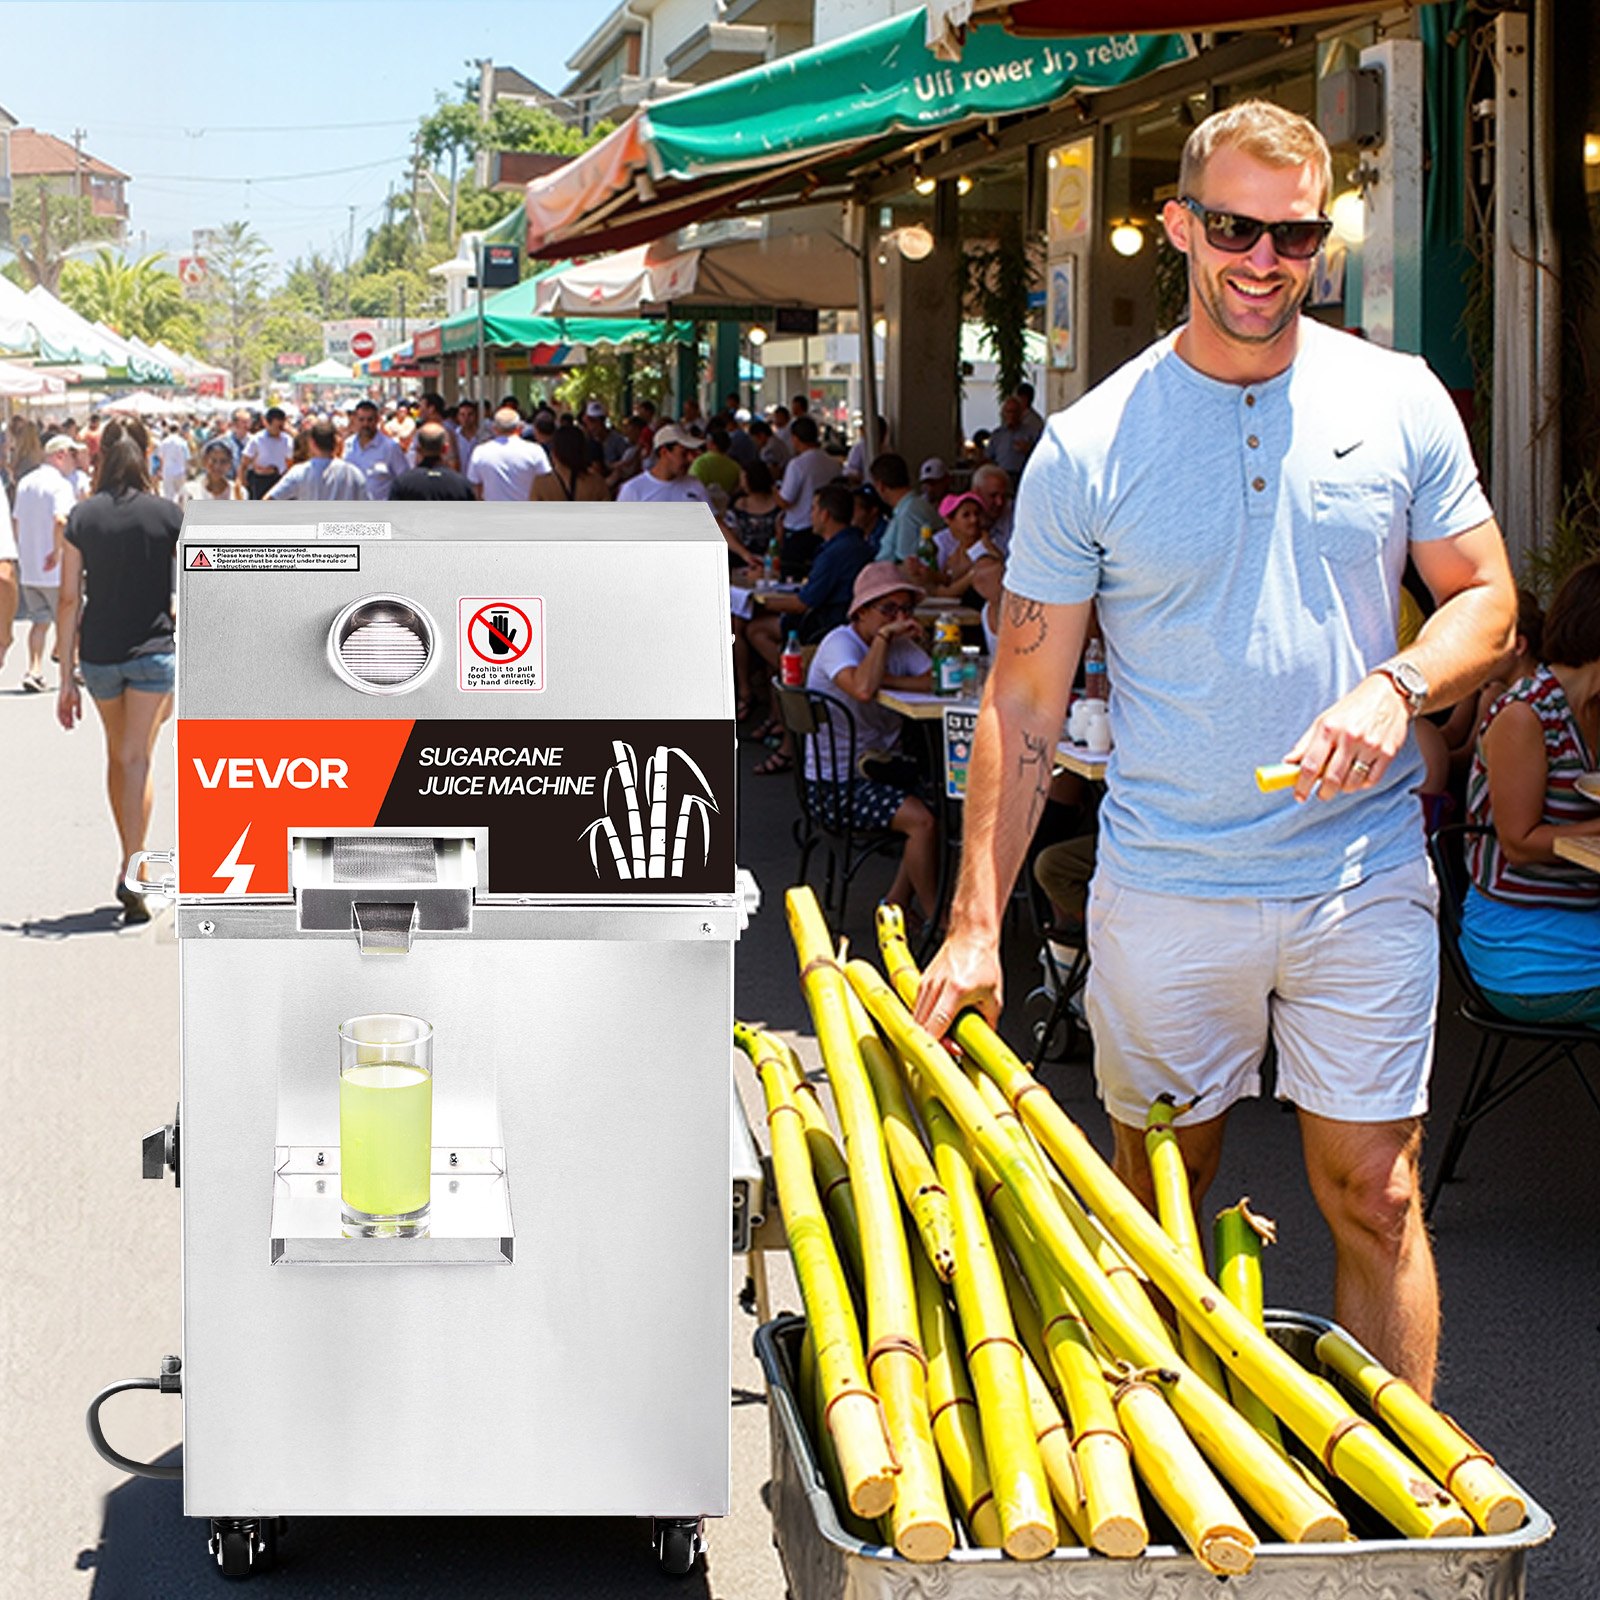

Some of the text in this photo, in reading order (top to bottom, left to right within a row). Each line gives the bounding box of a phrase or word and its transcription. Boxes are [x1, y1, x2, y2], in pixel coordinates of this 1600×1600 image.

[517, 665, 533, 673] pull
[467, 679, 477, 687] by
[503, 679, 536, 687] directly.
[418, 747, 564, 767] SUGARCANE
[192, 757, 349, 789] VEVOR
[418, 776, 596, 796] JUICE MACHINE
